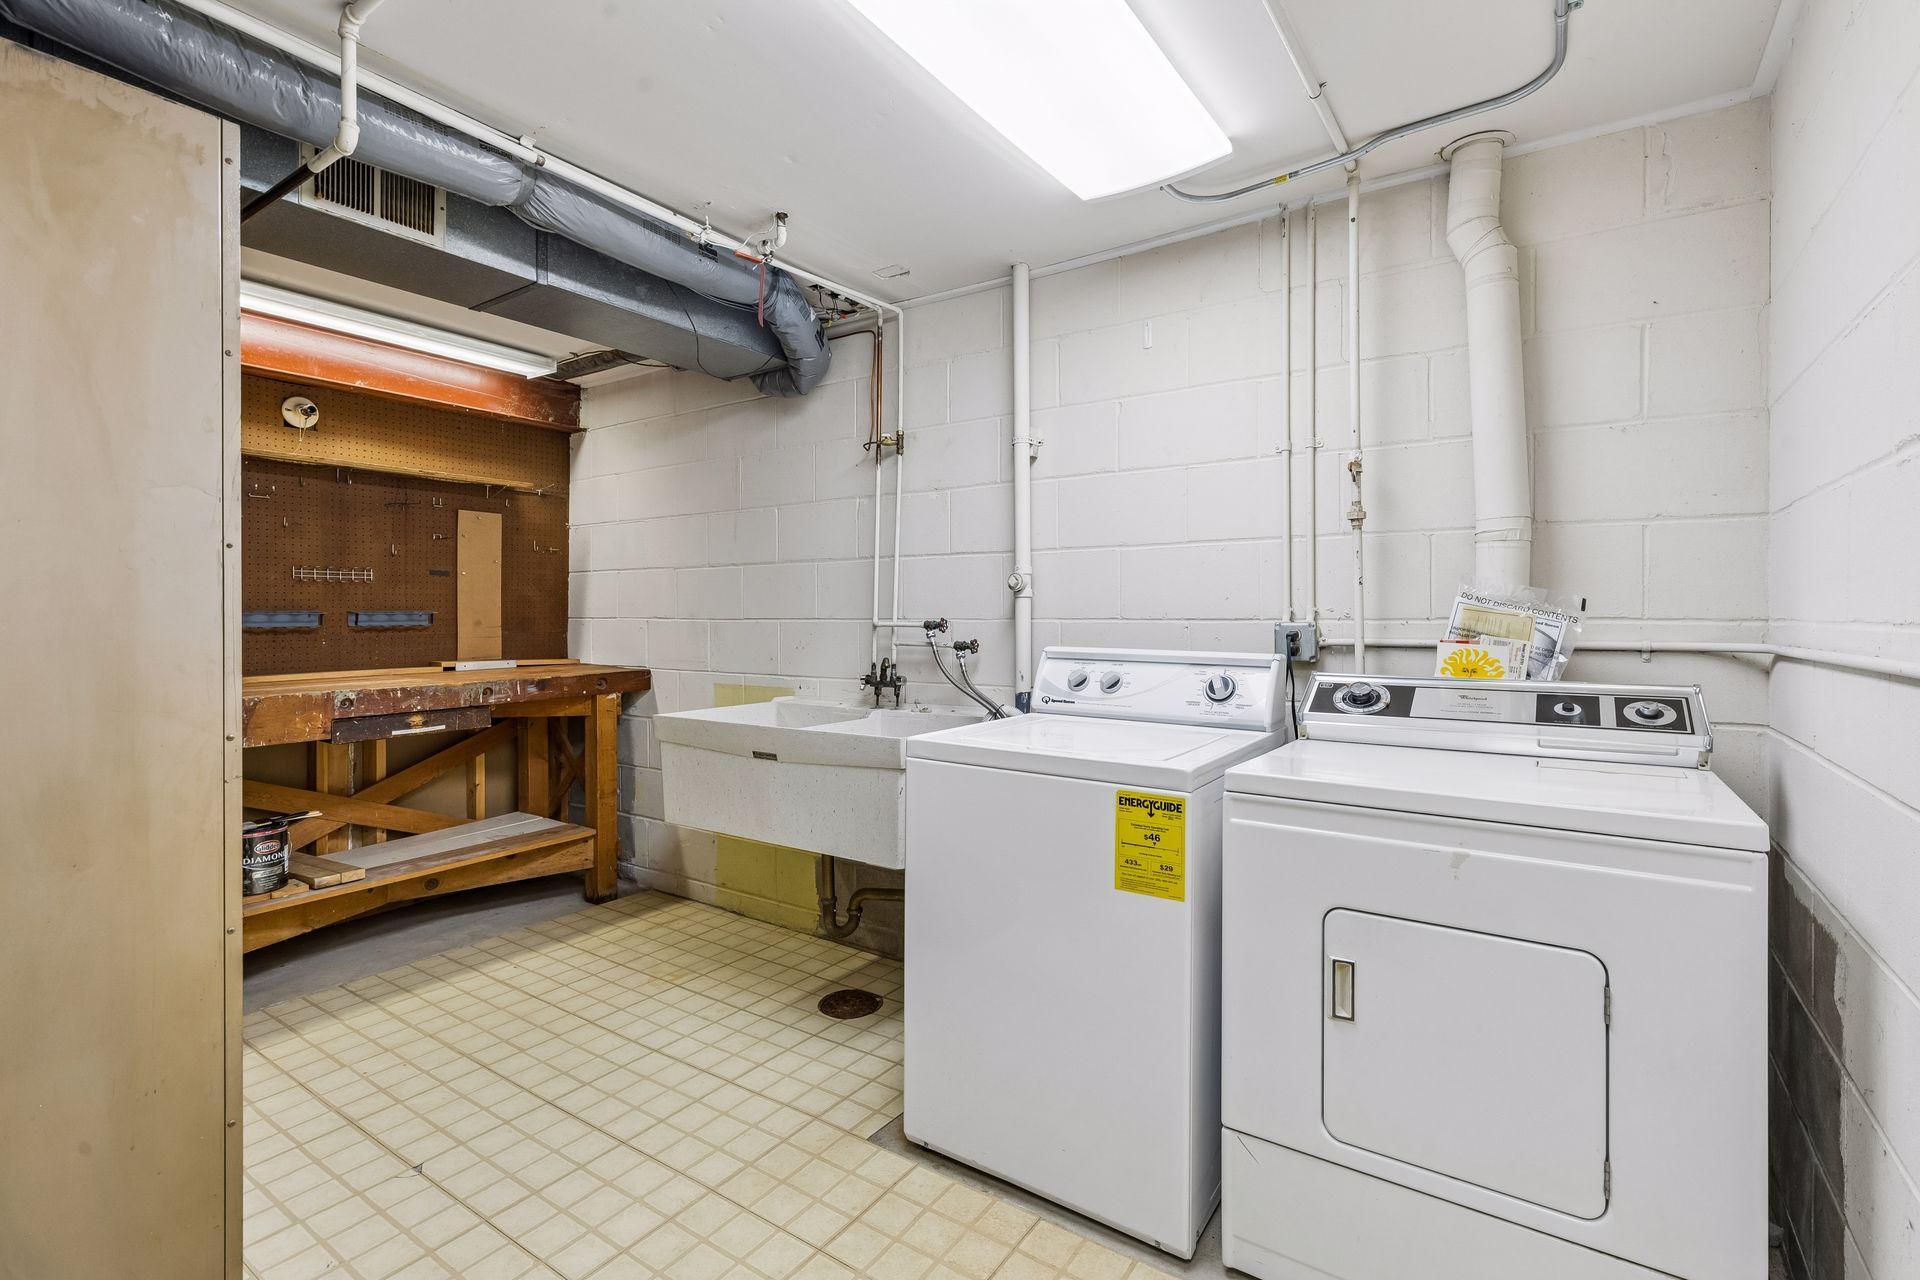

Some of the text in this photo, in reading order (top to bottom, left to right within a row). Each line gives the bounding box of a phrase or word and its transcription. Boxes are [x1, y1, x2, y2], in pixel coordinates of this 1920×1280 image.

[1461, 592, 1579, 624] DO NOT DISCARD CONTENTS
[1118, 796, 1183, 813] ENERGYGUIDE
[1144, 833, 1161, 842] $46
[1124, 858, 1138, 866] 433
[1159, 864, 1174, 872] $29
